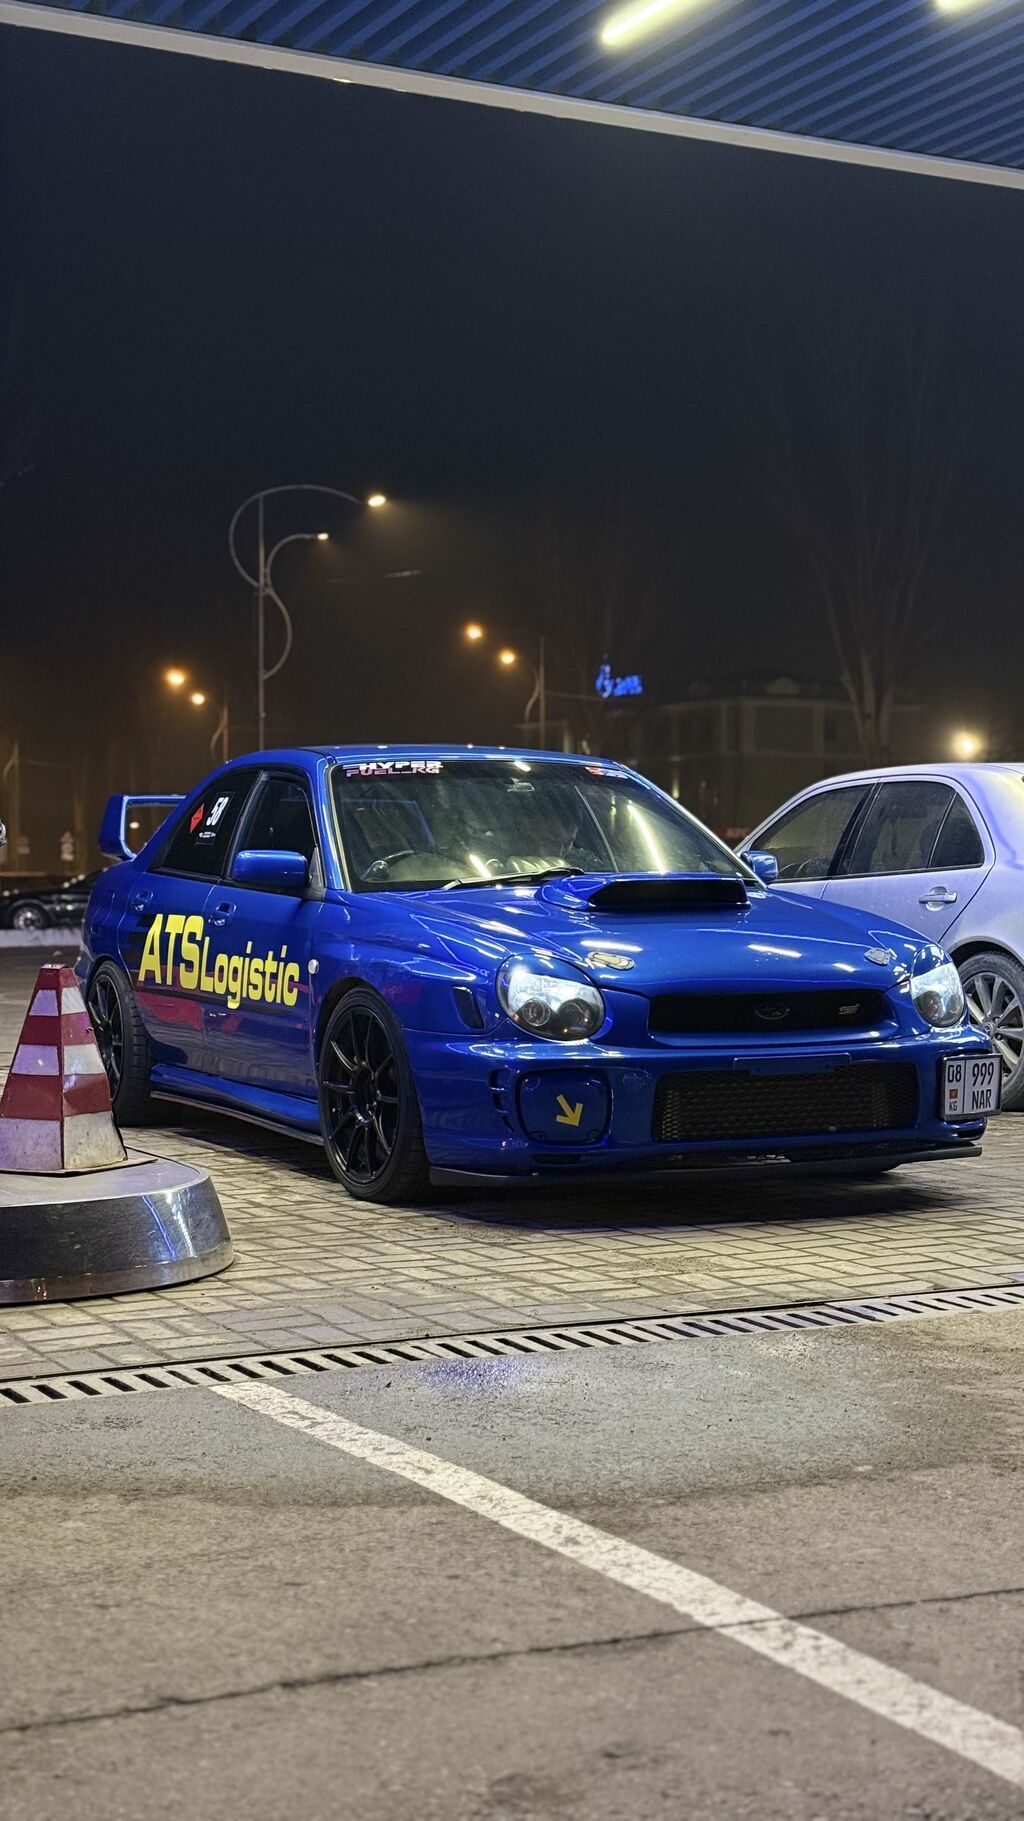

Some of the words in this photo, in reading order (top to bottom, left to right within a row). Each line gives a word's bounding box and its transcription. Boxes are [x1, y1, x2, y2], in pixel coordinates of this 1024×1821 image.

[358, 760, 444, 771] HYPER
[947, 1064, 962, 1083] 08
[972, 1062, 994, 1087] 999
[948, 1101, 958, 1111] KG
[971, 1089, 992, 1110] NAR
